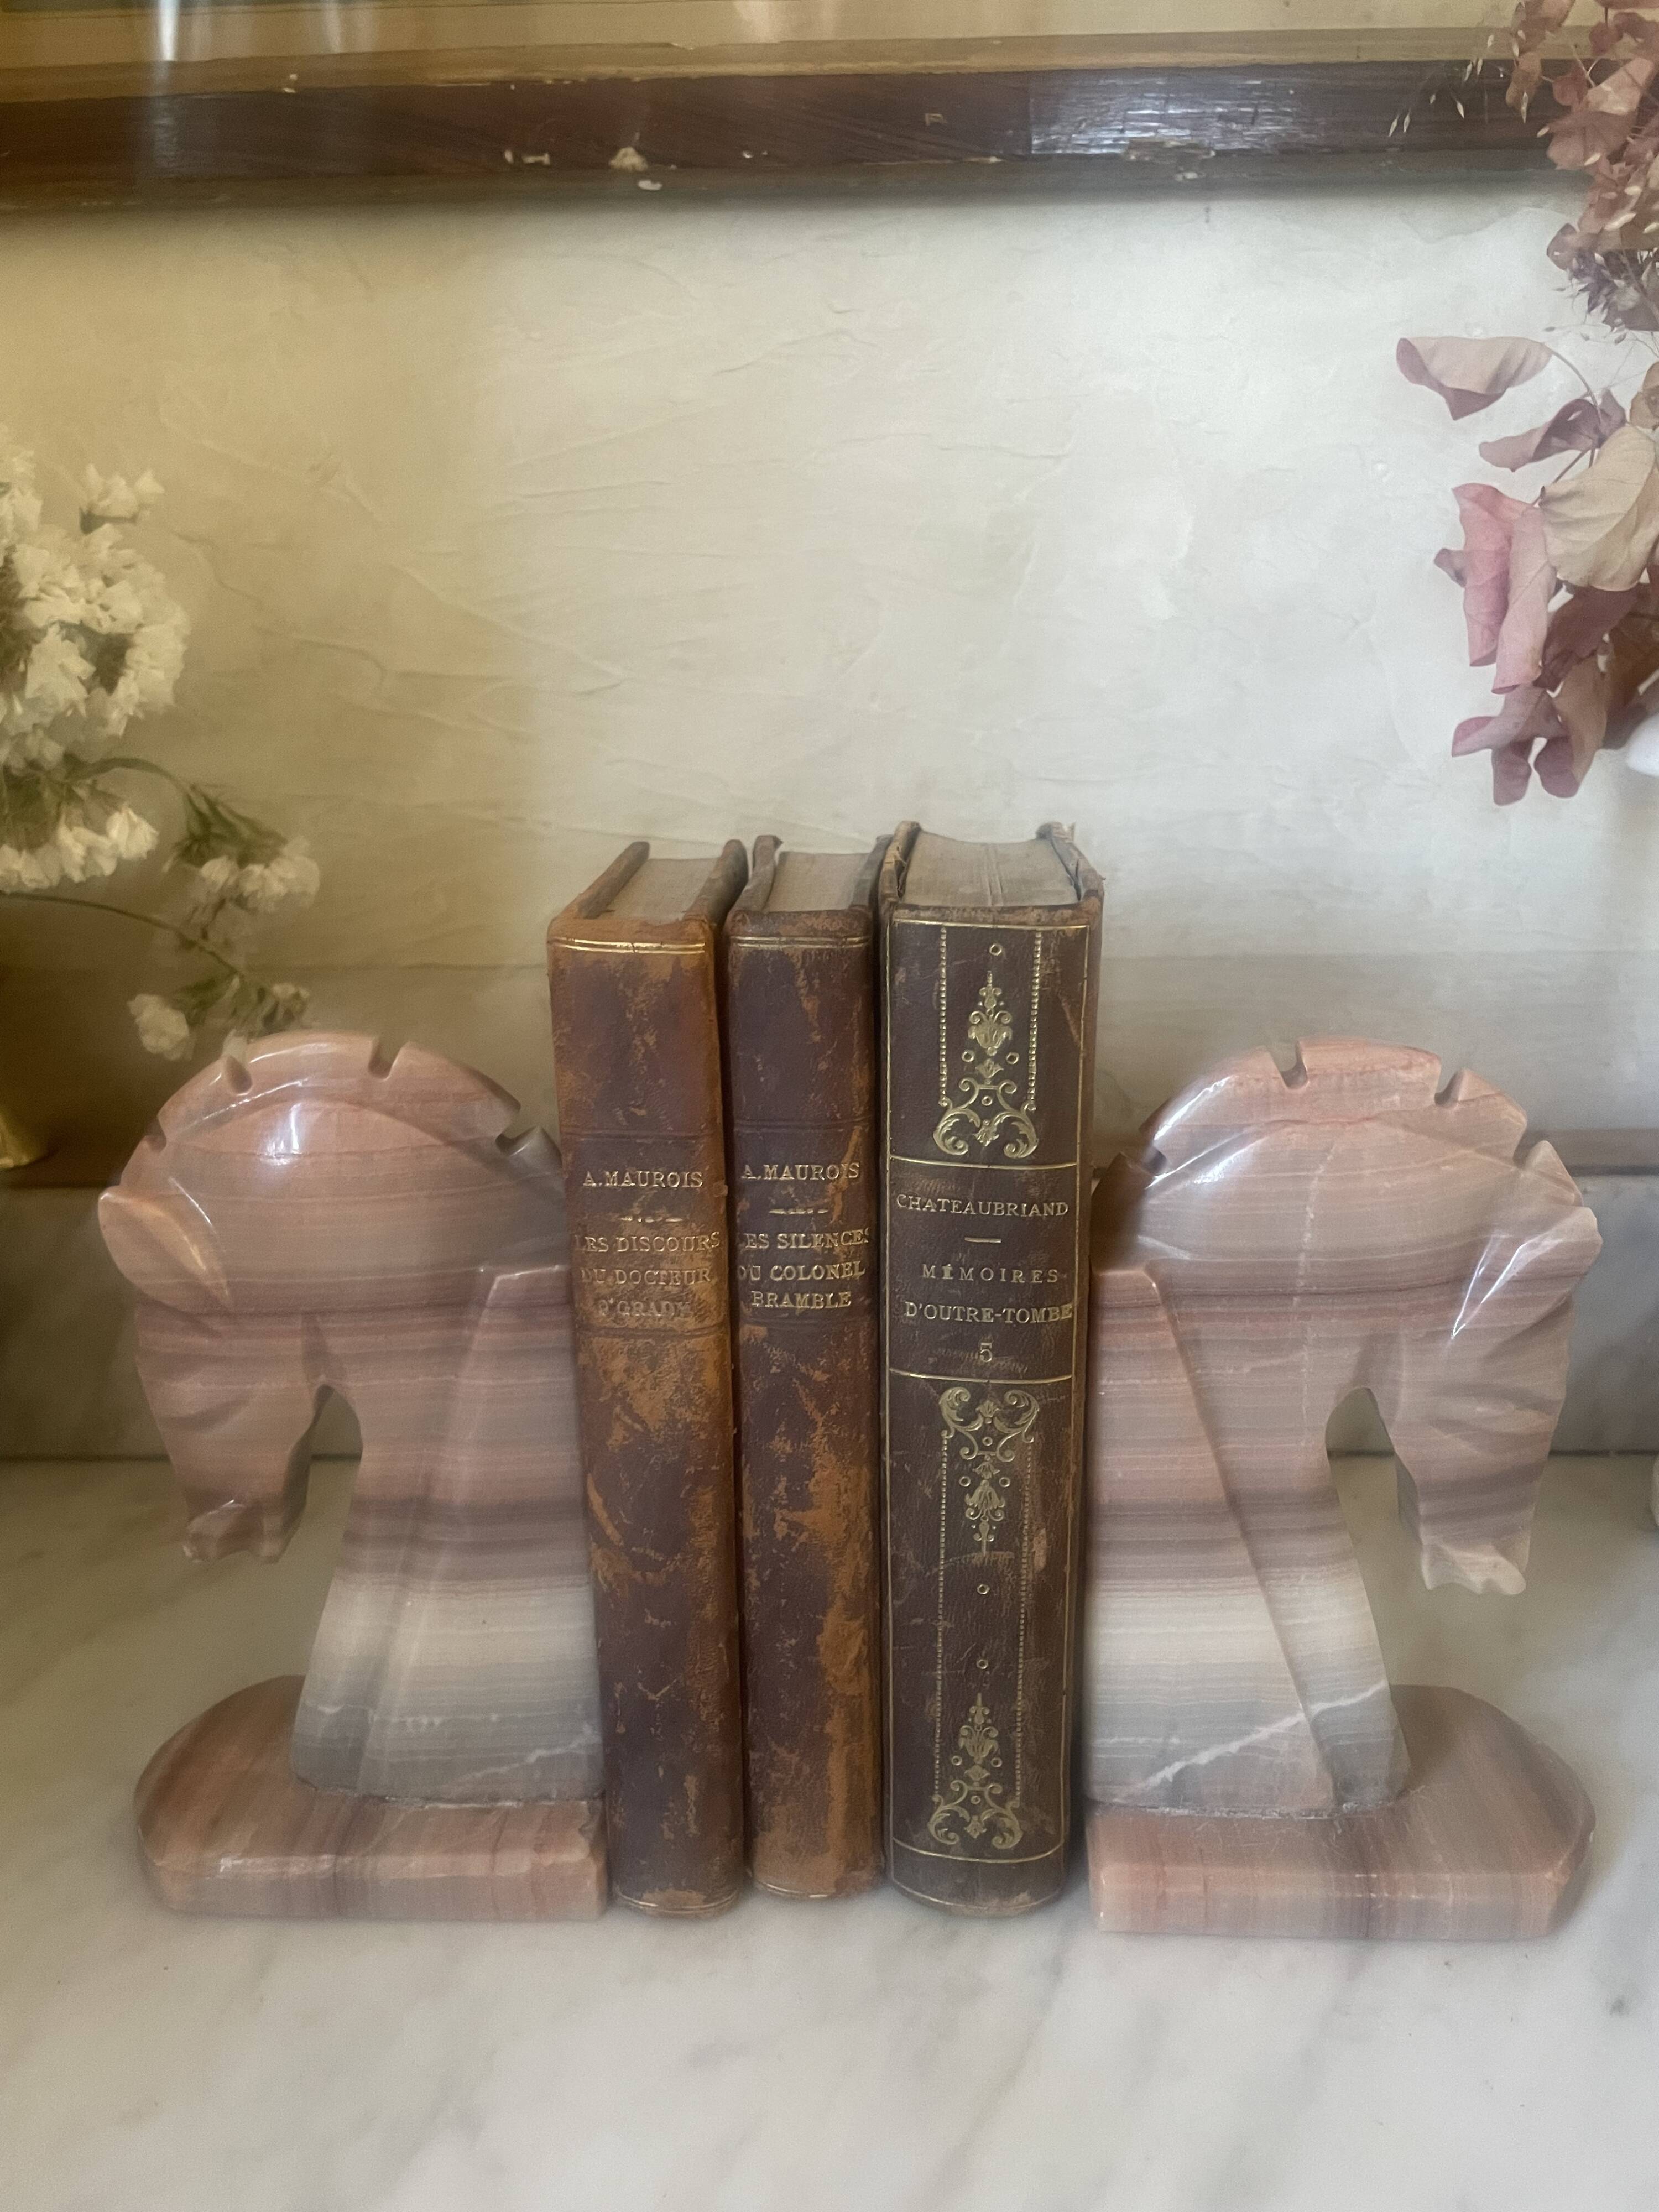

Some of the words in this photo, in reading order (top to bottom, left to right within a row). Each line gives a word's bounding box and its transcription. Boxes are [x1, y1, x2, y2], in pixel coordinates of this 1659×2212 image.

[582, 1170, 703, 1188] A.MAUROIS
[740, 1162, 859, 1180] A.MAUROIS
[896, 1194, 1068, 1217] CHATEAUBRIAND
[615, 1232, 720, 1253] DISCOURS
[614, 1268, 711, 1285] DOCTEUR
[769, 1260, 866, 1282] COLONEL
[750, 1290, 852, 1310] BRAMBLE
[905, 1301, 1073, 1324] D'OUTRE-TOMBE
[979, 1342, 993, 1363] 5
